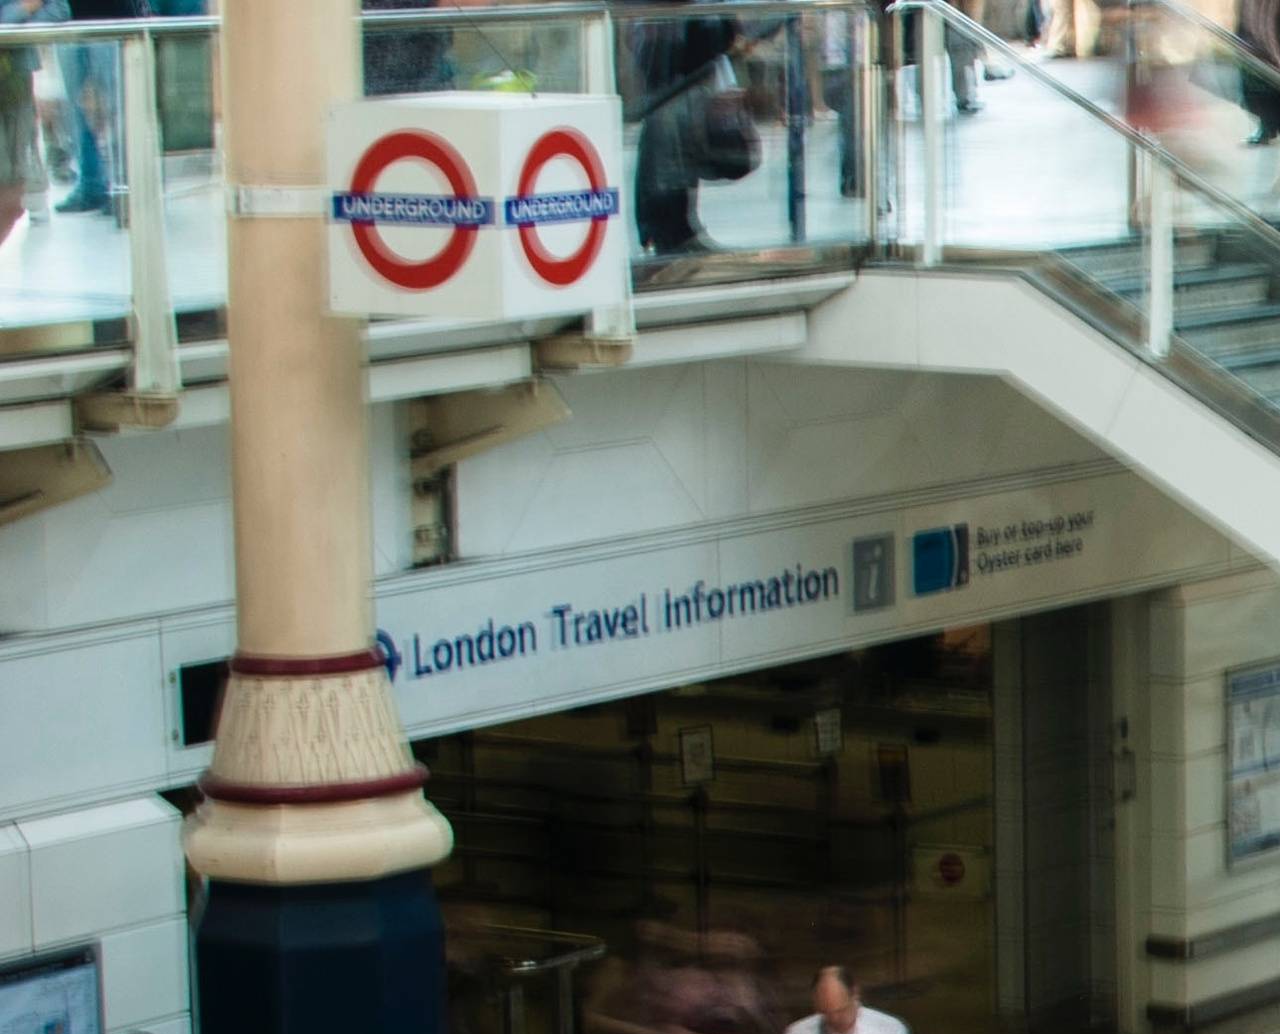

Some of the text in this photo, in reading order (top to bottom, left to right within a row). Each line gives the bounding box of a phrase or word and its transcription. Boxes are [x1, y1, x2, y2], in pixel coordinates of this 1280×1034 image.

[341, 194, 486, 219] UNDERGROUND
[510, 192, 614, 219] UNDERGROUND
[976, 526, 1001, 546] Buy
[1067, 510, 1095, 533] your
[976, 536, 1084, 574] Oyster card here
[411, 563, 840, 677] London Travel Information
